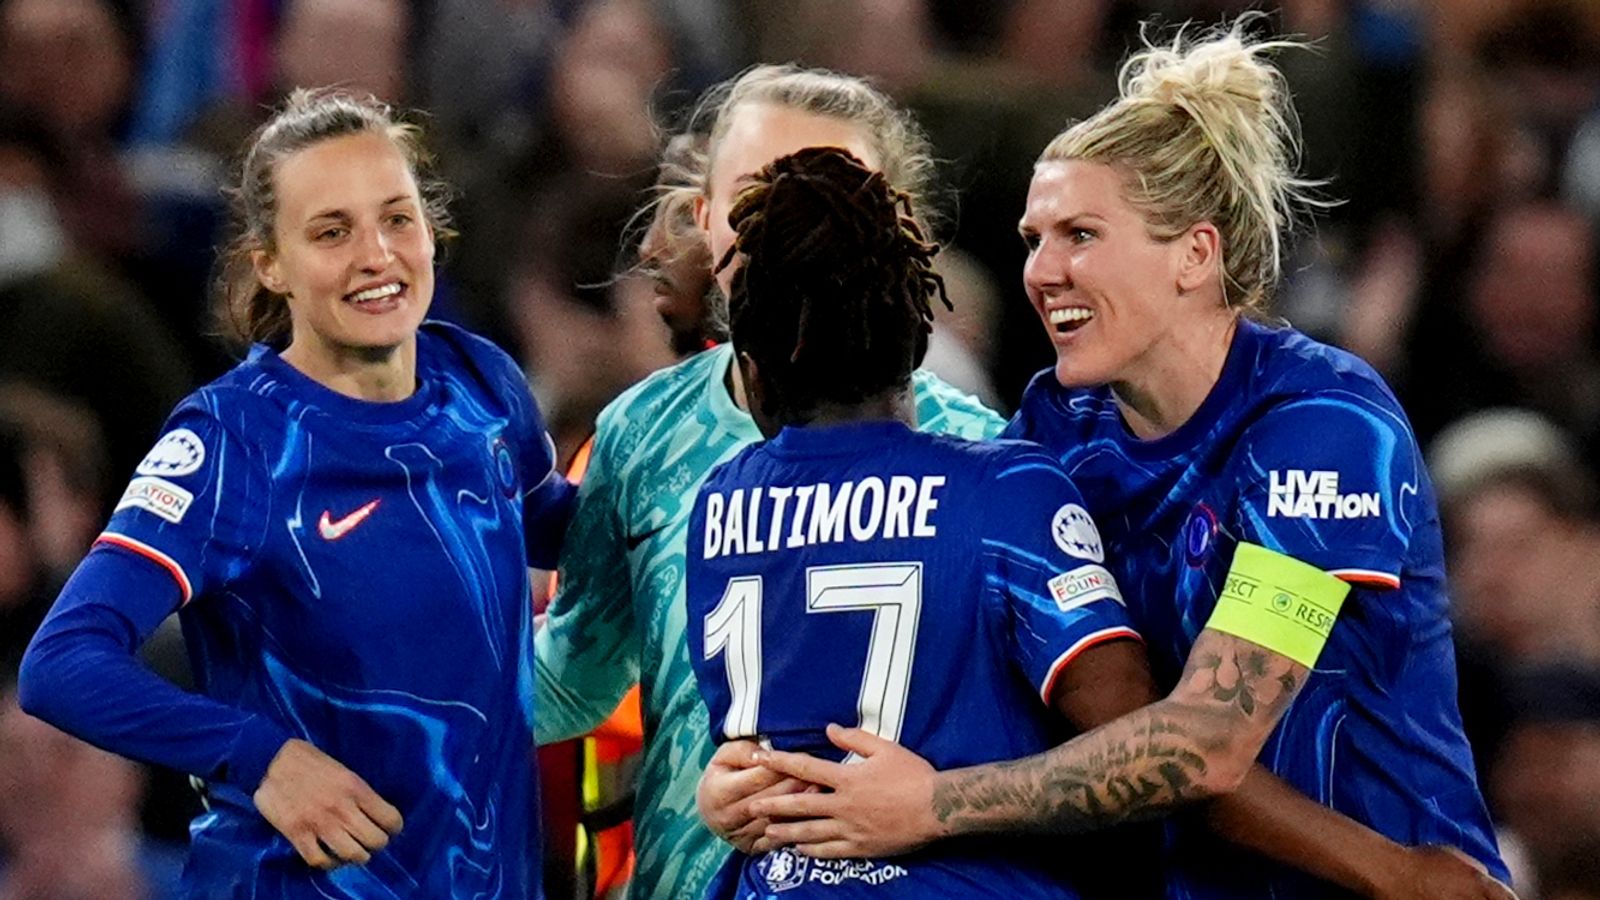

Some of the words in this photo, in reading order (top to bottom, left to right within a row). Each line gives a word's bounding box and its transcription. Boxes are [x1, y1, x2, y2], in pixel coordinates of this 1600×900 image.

[1269, 470, 1339, 496] LIVE
[129, 484, 187, 512] ATION
[1267, 493, 1381, 519] NATION
[703, 476, 945, 560] BALTIMORE
[1296, 603, 1333, 633] RESP
[704, 561, 923, 764] 17
